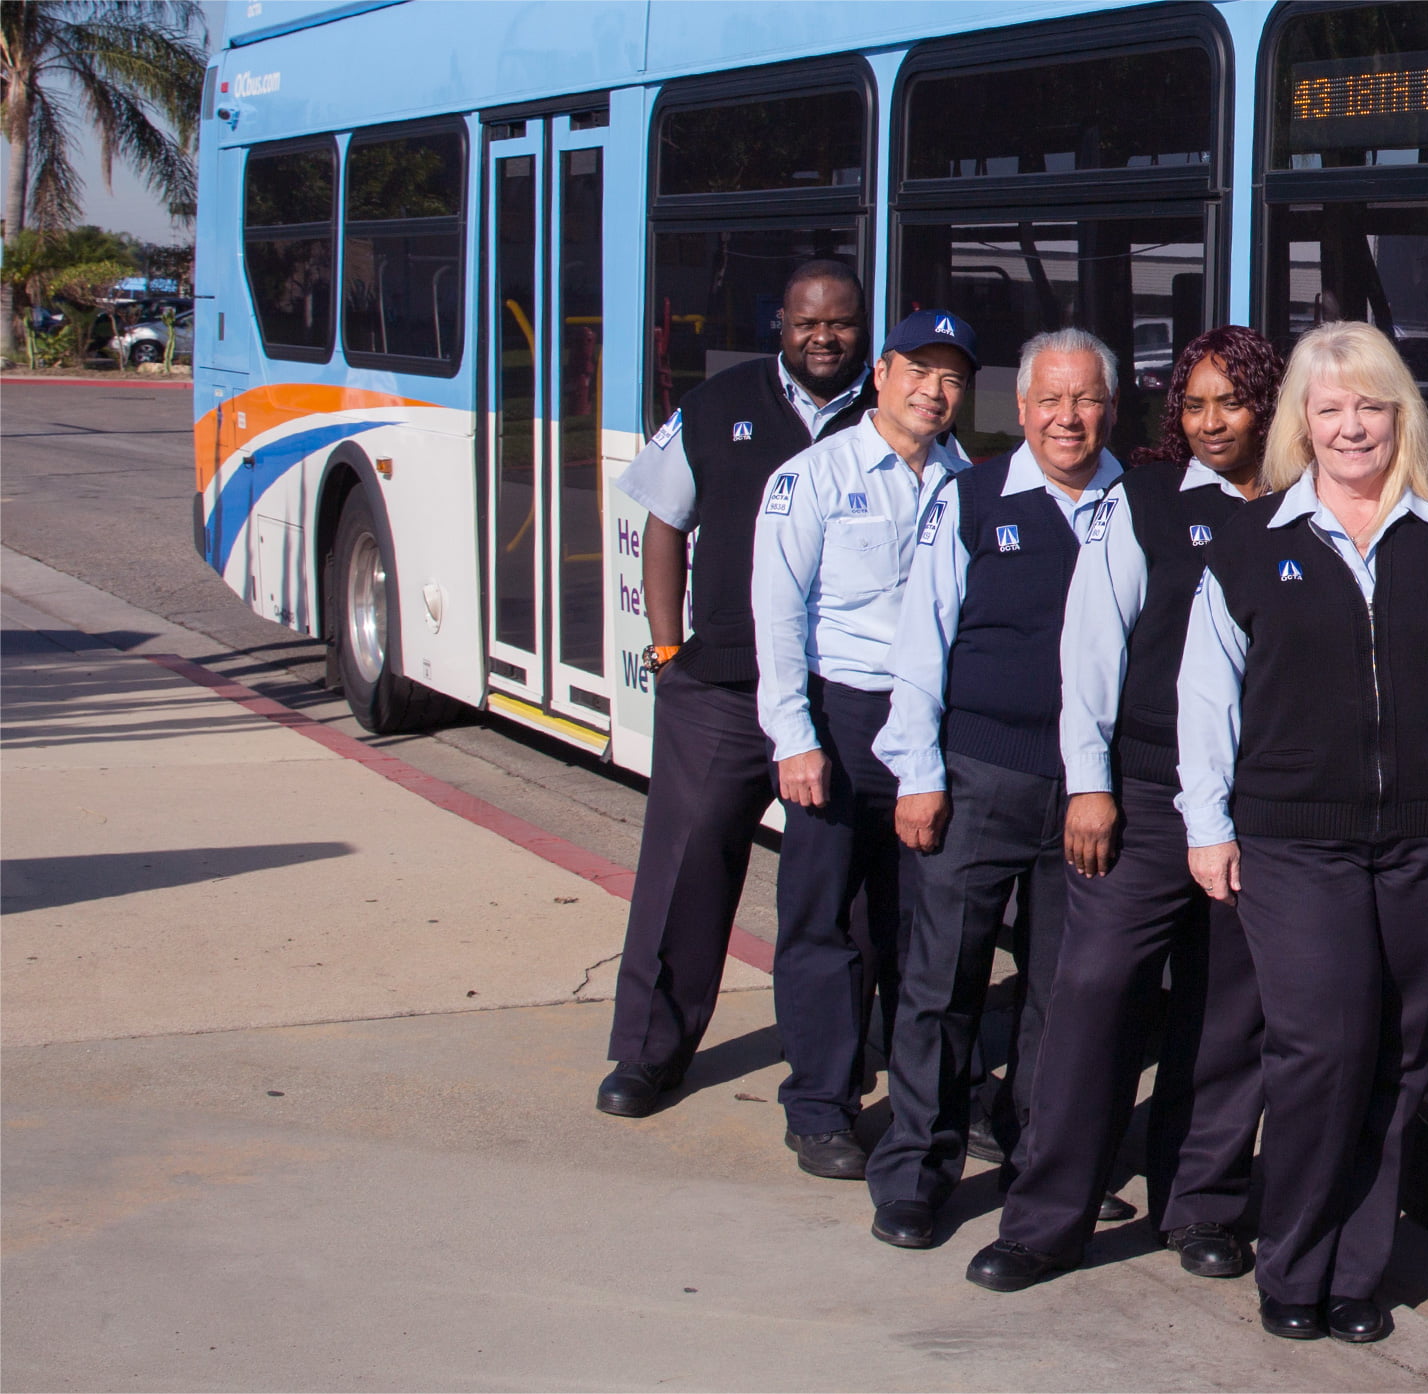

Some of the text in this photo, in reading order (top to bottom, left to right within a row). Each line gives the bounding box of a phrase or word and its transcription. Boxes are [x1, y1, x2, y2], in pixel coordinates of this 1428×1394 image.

[234, 71, 281, 99] OCbus.com
[1294, 78, 1330, 119] 43
[1346, 71, 1409, 116] 18TH
[934, 327, 956, 338] OCTA
[732, 434, 752, 442] OCTA
[770, 493, 789, 501] OCTA
[618, 517, 640, 559] He
[1000, 544, 1021, 553] OCTA
[1281, 573, 1303, 582] OCTA
